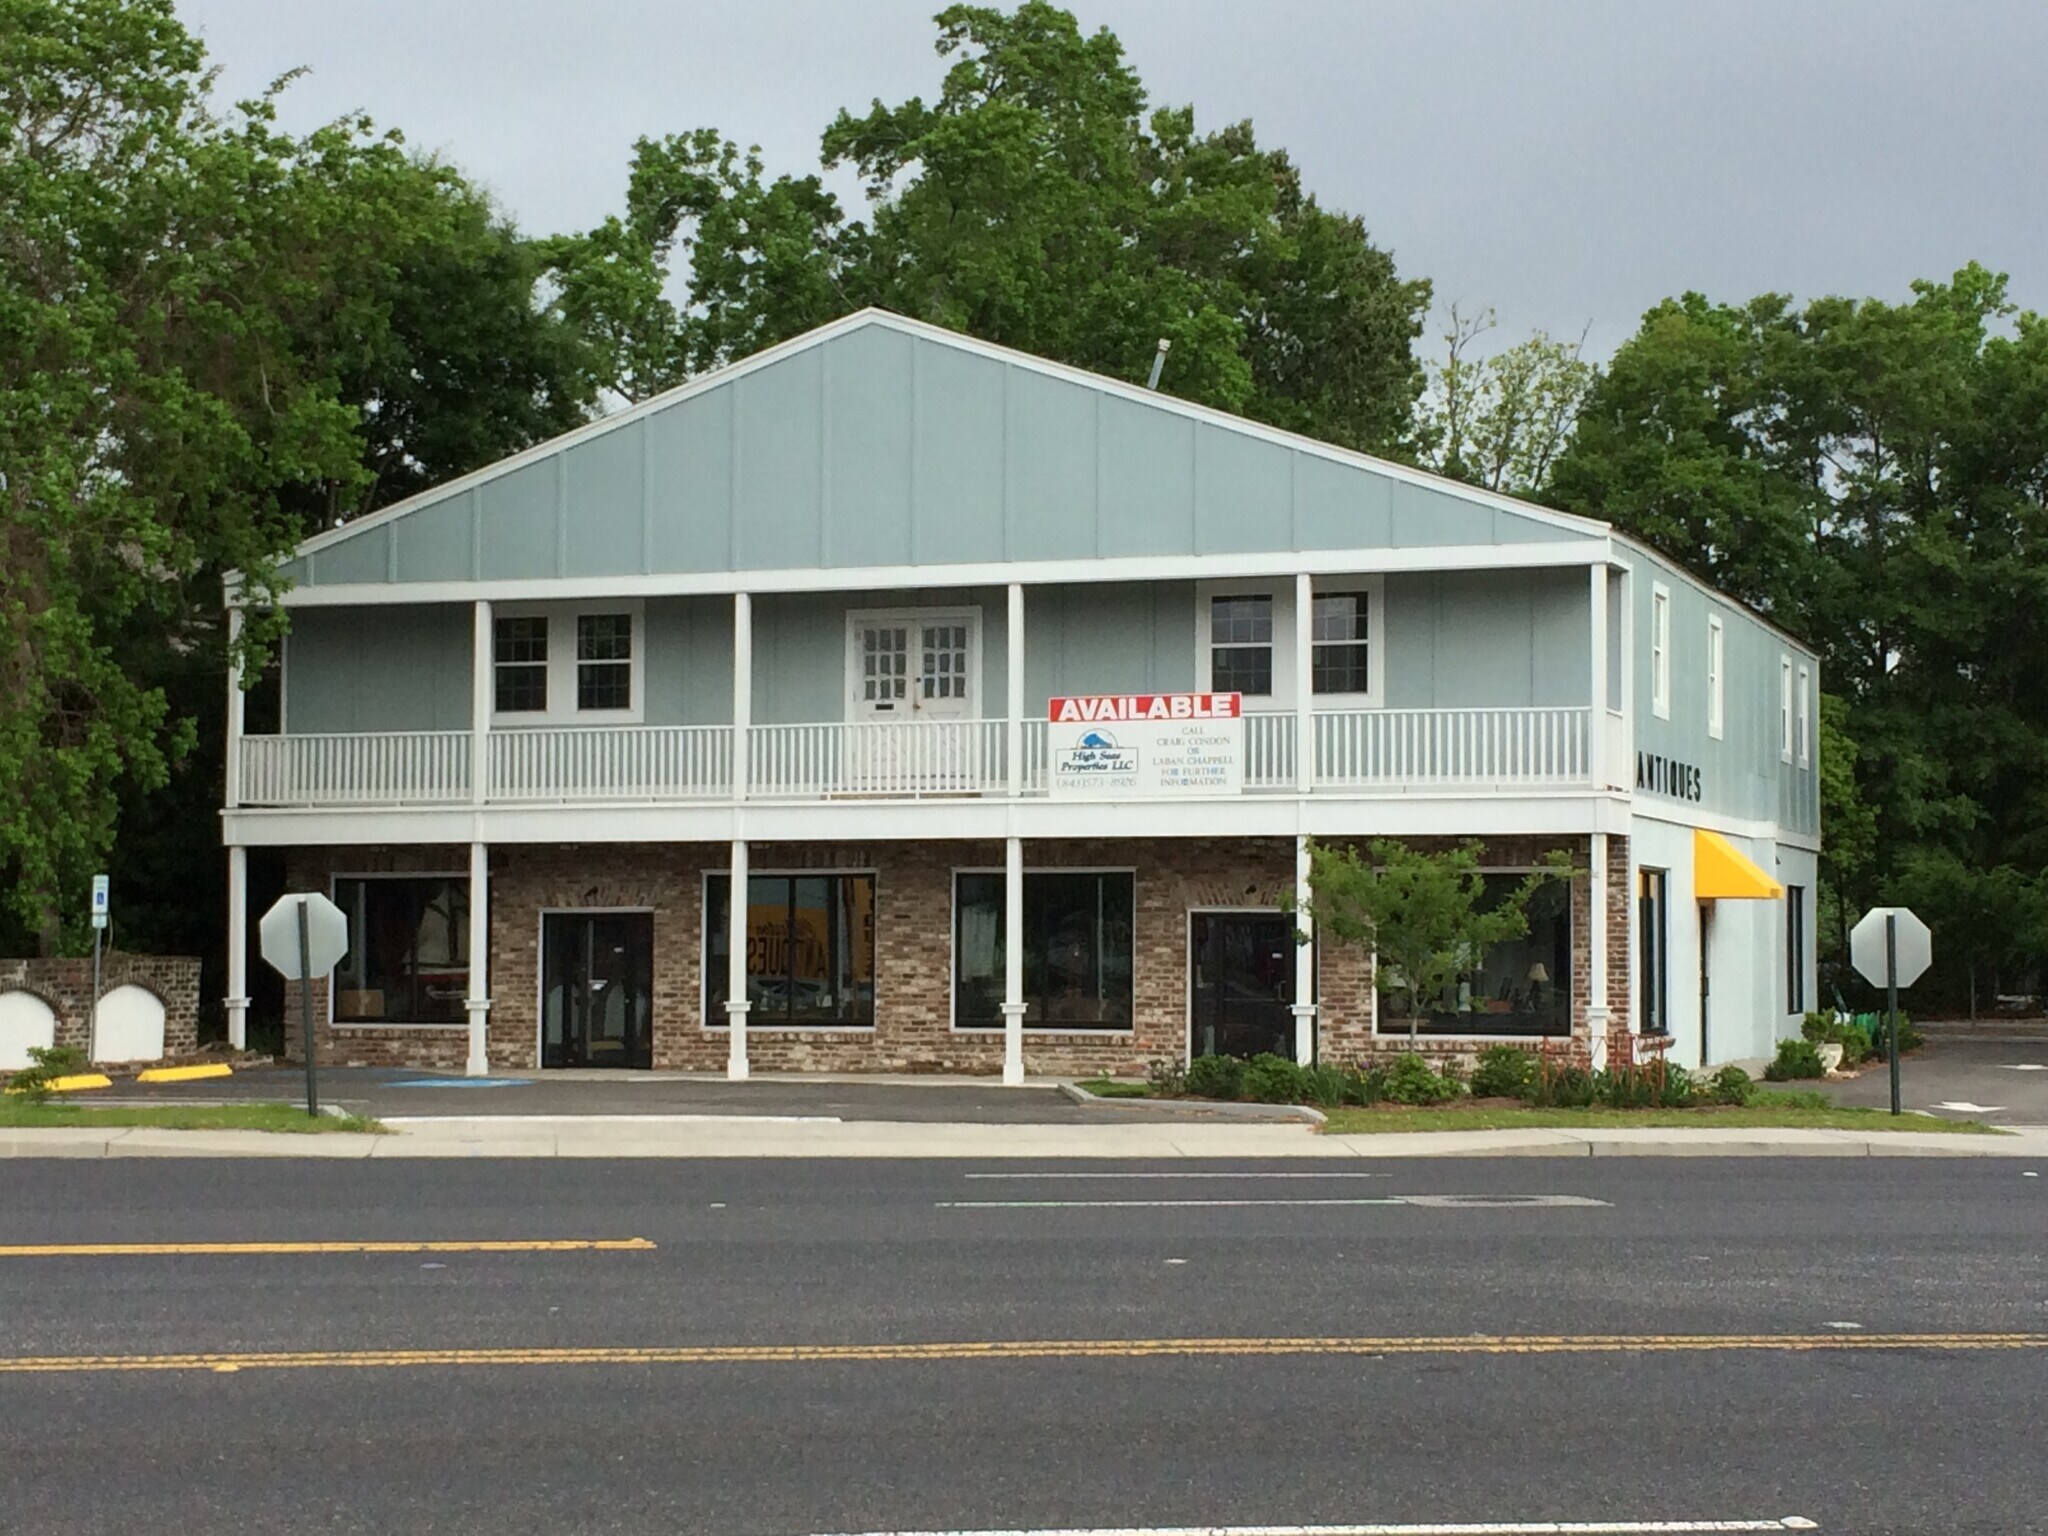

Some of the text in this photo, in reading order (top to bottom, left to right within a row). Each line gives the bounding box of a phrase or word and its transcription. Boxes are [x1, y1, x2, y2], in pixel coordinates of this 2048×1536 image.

[1058, 694, 1232, 721] AVAILABLE
[1181, 726, 1204, 735] CALL
[1188, 736, 1231, 746] CONDON
[1186, 746, 1200, 755] OR
[1071, 750, 1121, 762] High Seas
[1152, 755, 1234, 766] LABAN CHAPPELL
[1060, 760, 1134, 774] Properties LLC
[1161, 767, 1226, 776] FOR FURTHER
[1636, 750, 1701, 802] ANTIQUES
[1160, 777, 1228, 787] INFORMATION
